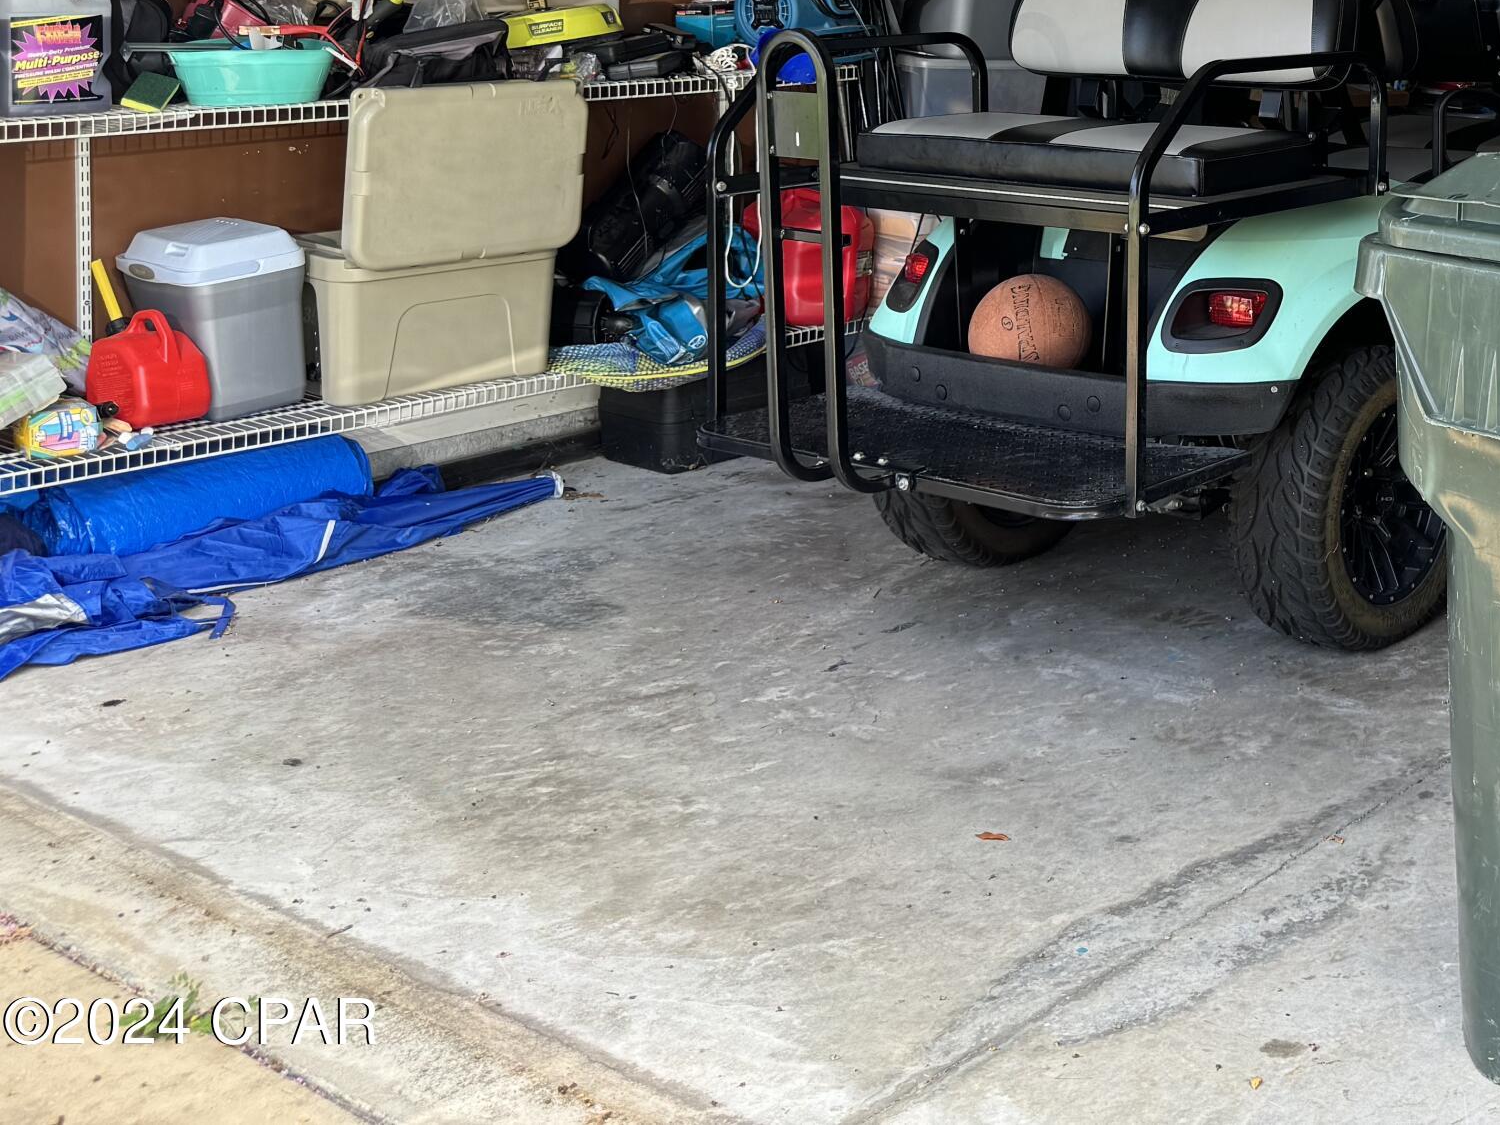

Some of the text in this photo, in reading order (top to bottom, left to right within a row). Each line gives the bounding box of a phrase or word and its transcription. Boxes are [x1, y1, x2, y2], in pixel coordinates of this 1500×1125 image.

[531, 21, 563, 30] SURFACE
[533, 26, 562, 34] CLEANER
[15, 51, 100, 70] Multi-Purpose
